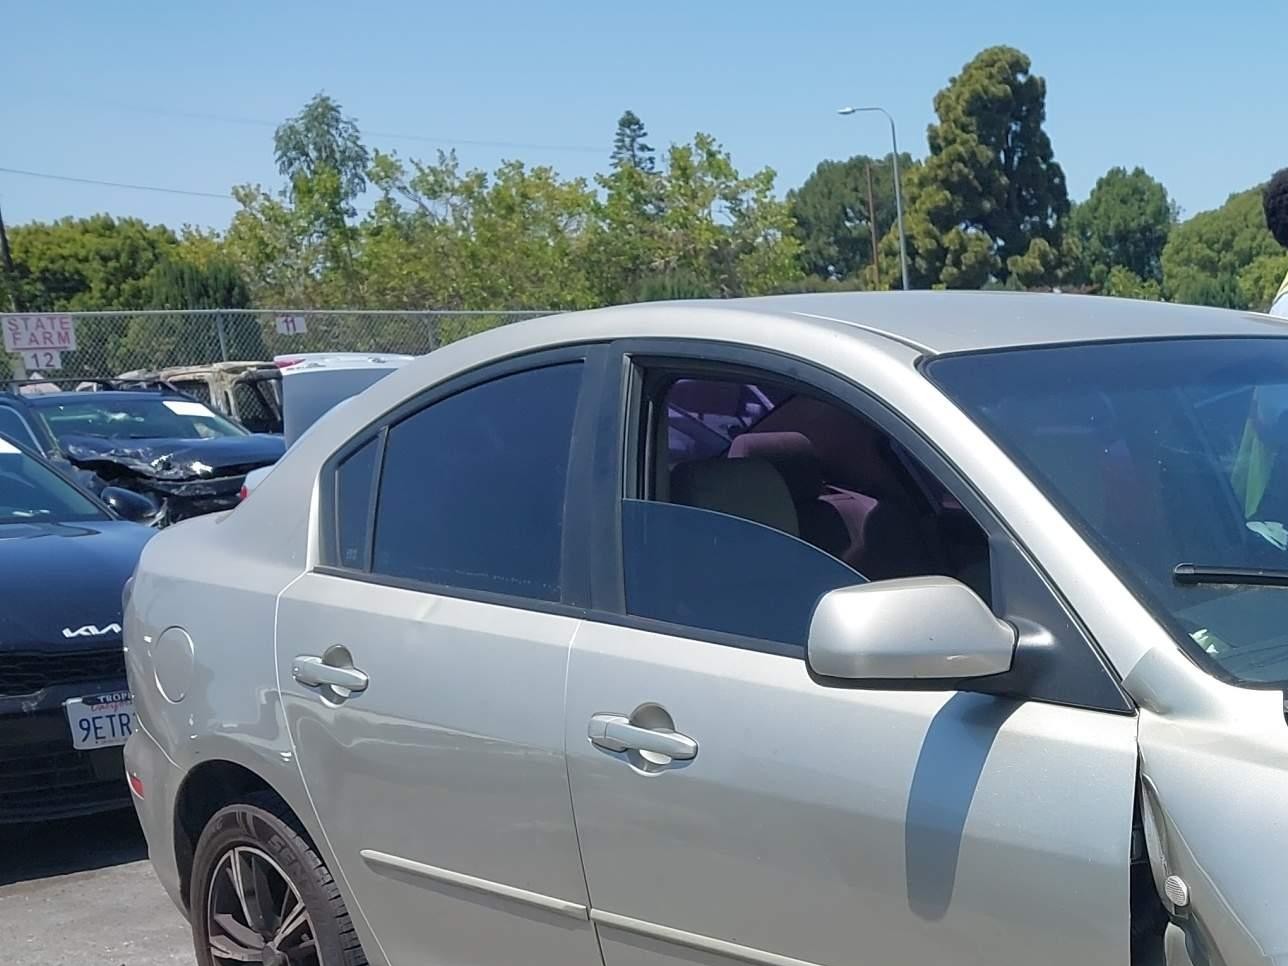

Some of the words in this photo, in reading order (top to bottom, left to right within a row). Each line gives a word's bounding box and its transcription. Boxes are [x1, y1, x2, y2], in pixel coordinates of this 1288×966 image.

[8, 316, 71, 331] STATE
[11, 331, 71, 346] FARM
[31, 352, 55, 369] 12
[79, 713, 134, 743] 9ETR
